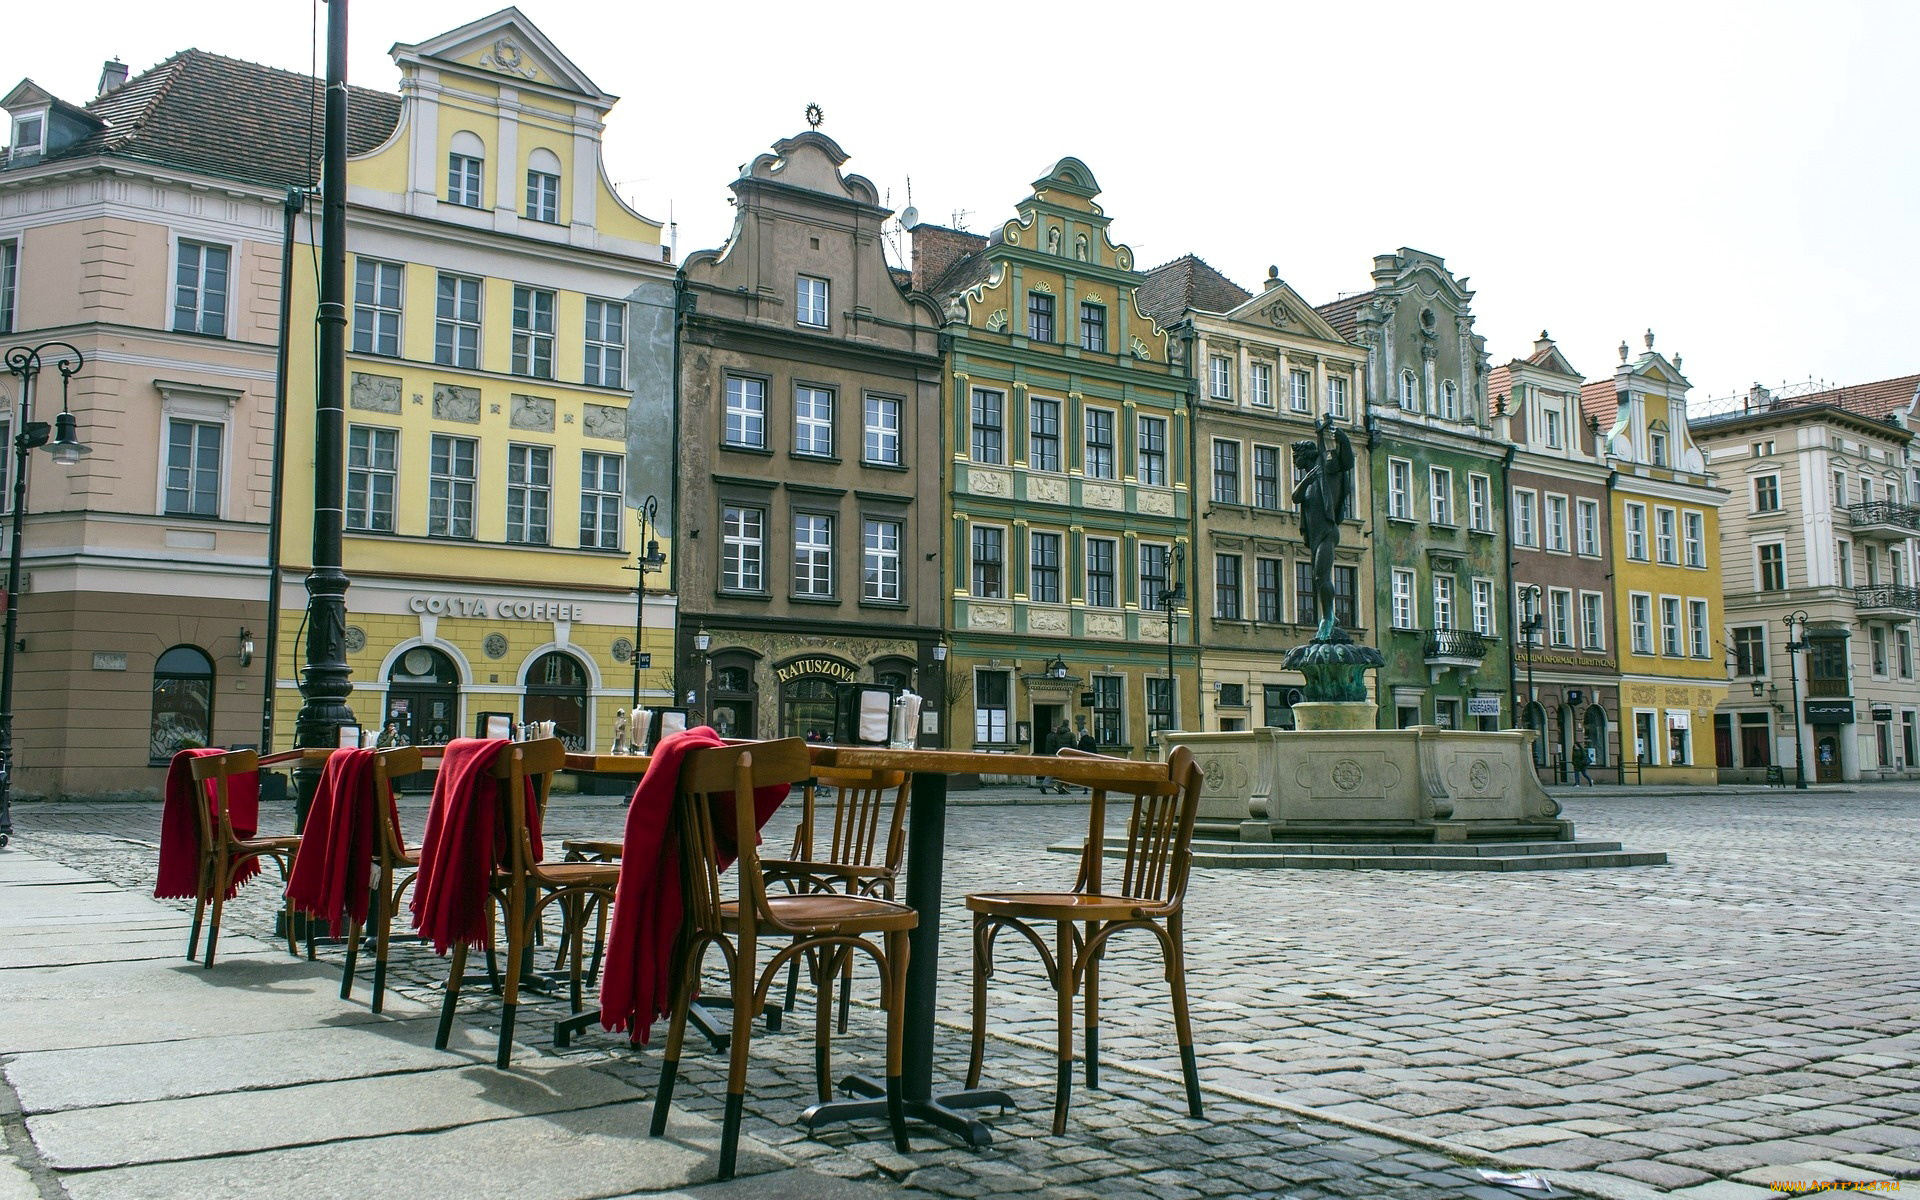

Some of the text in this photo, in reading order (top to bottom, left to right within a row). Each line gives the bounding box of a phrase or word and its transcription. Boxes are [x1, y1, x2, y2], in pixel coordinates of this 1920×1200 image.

[409, 594, 583, 621] COSTA COFFEE
[777, 659, 856, 683] RATUSZOVA
